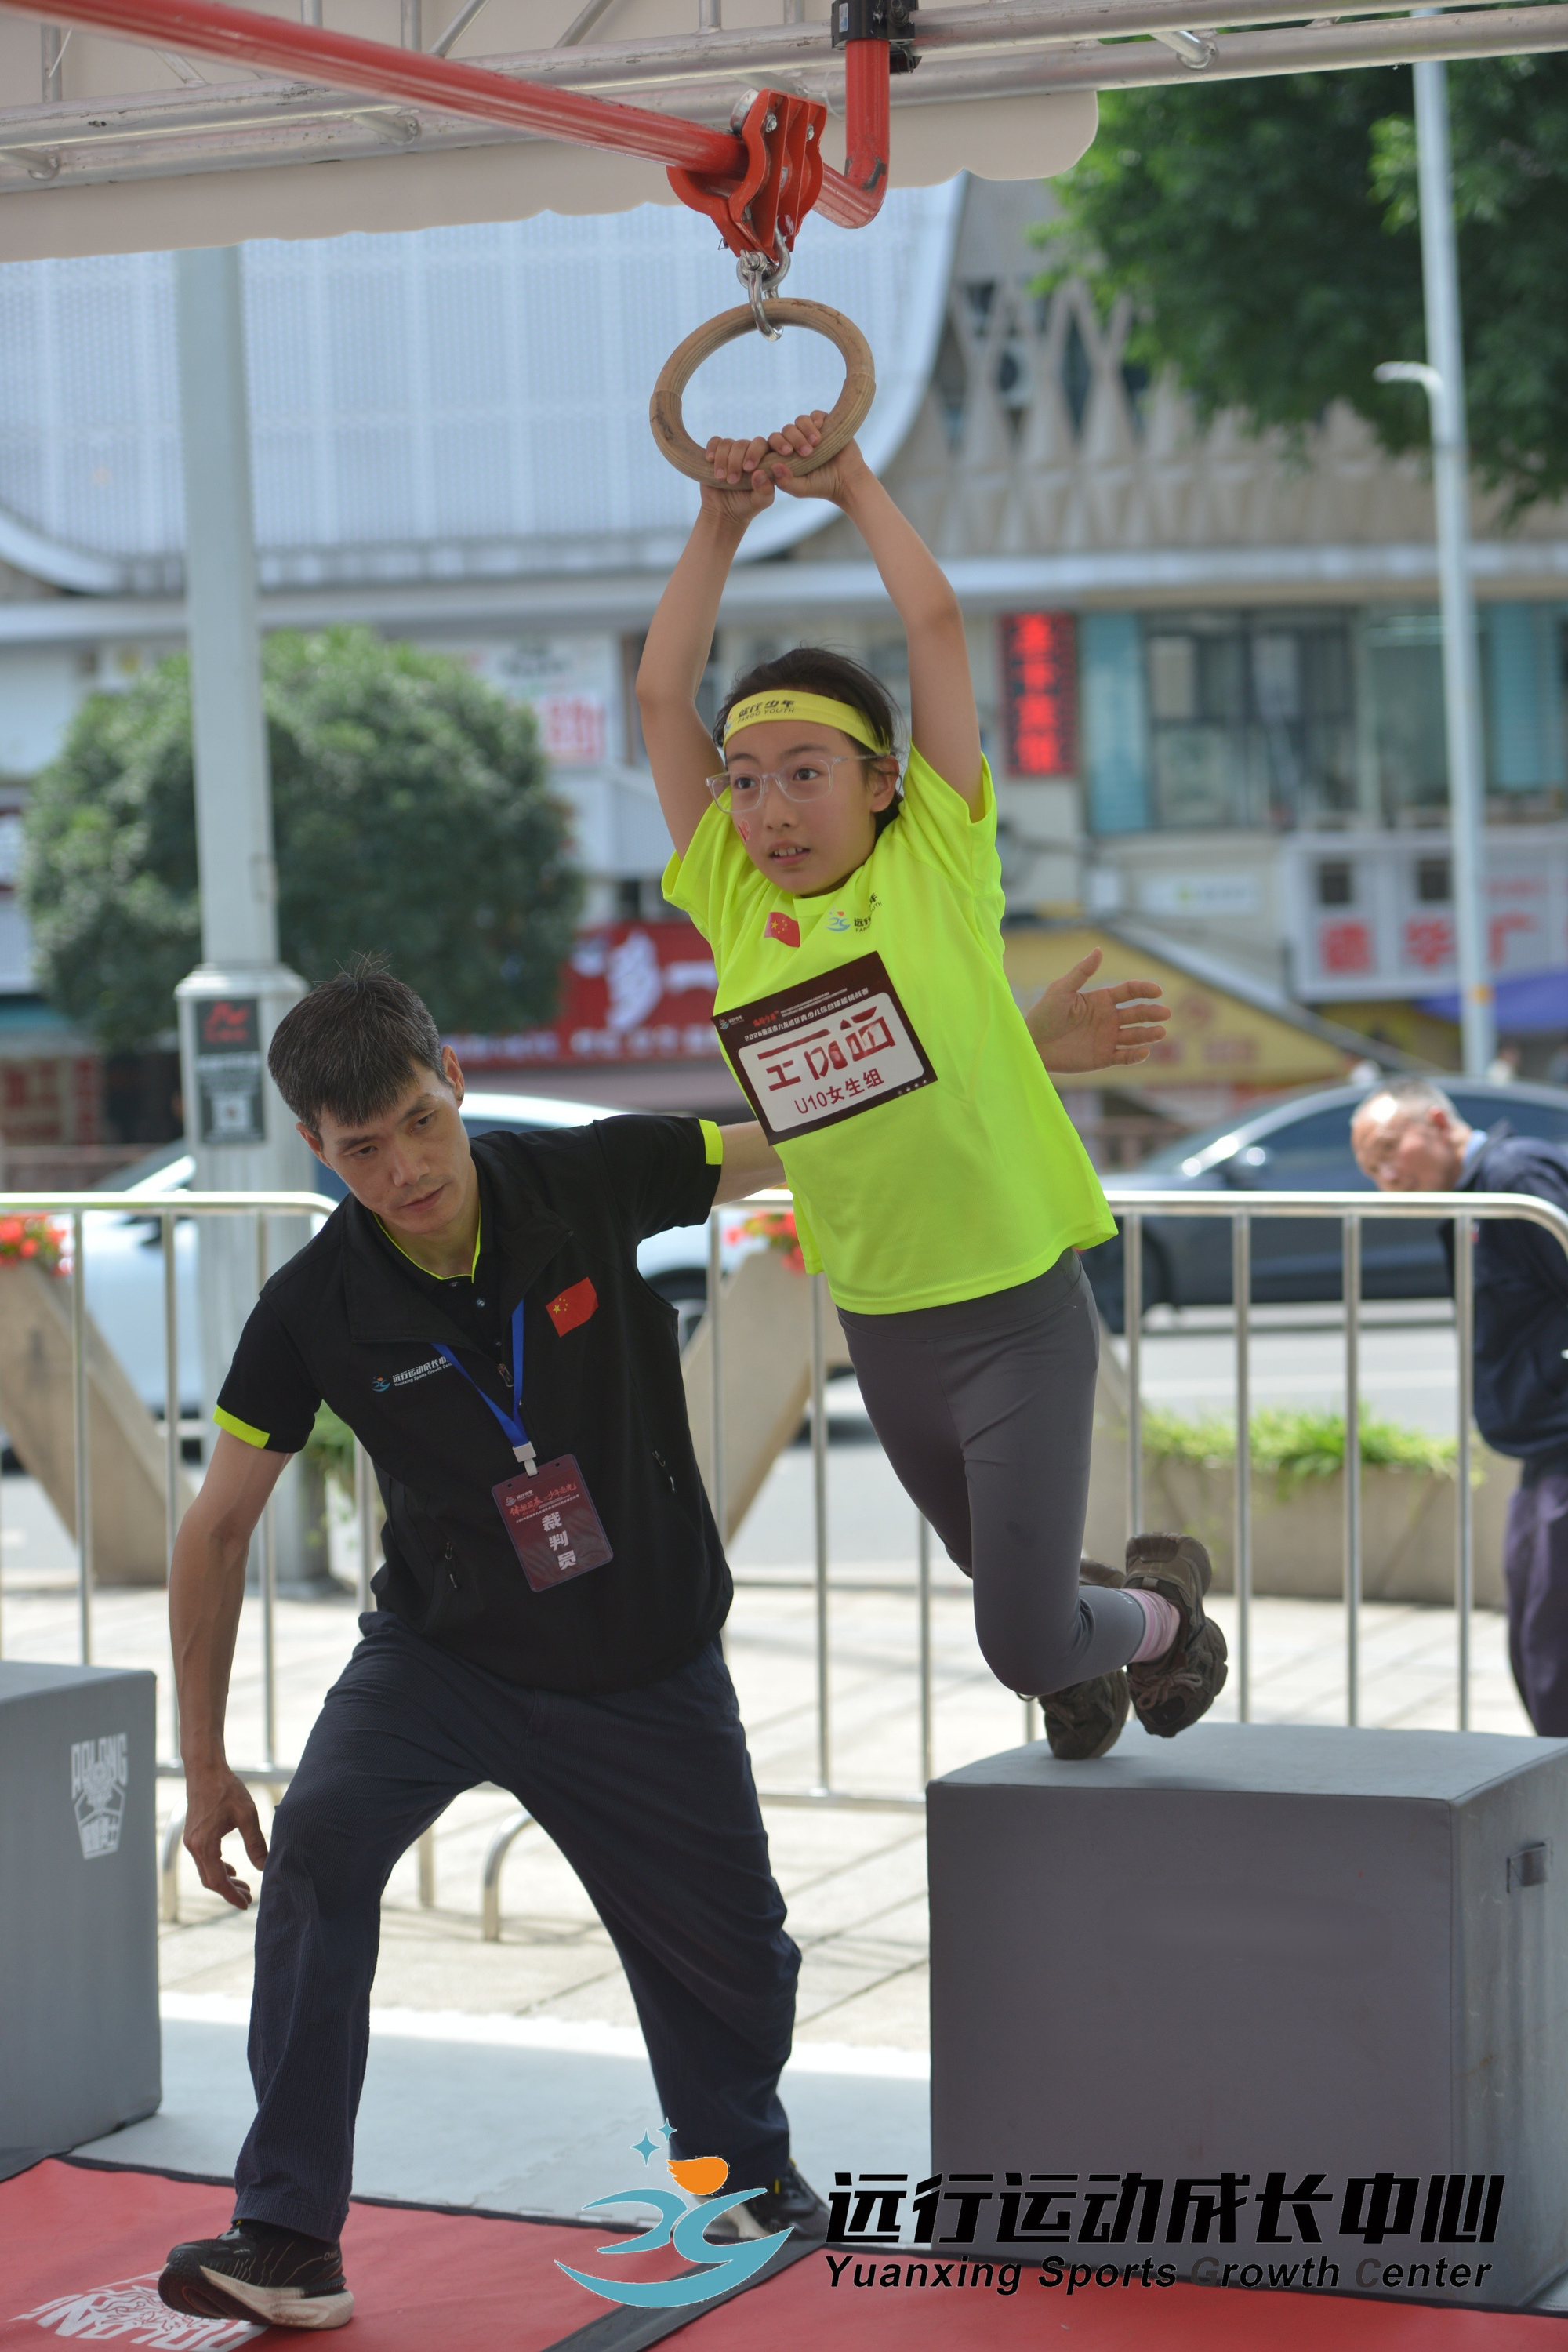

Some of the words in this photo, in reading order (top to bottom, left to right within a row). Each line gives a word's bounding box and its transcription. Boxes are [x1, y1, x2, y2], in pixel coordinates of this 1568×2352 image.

[793, 1067, 885, 1114] U10女生组
[392, 1356, 449, 1383] 远行运动成长中
[413, 1372, 427, 1381] Sports
[427, 1367, 442, 1375] Growth
[541, 1511, 577, 1571] 裁判员
